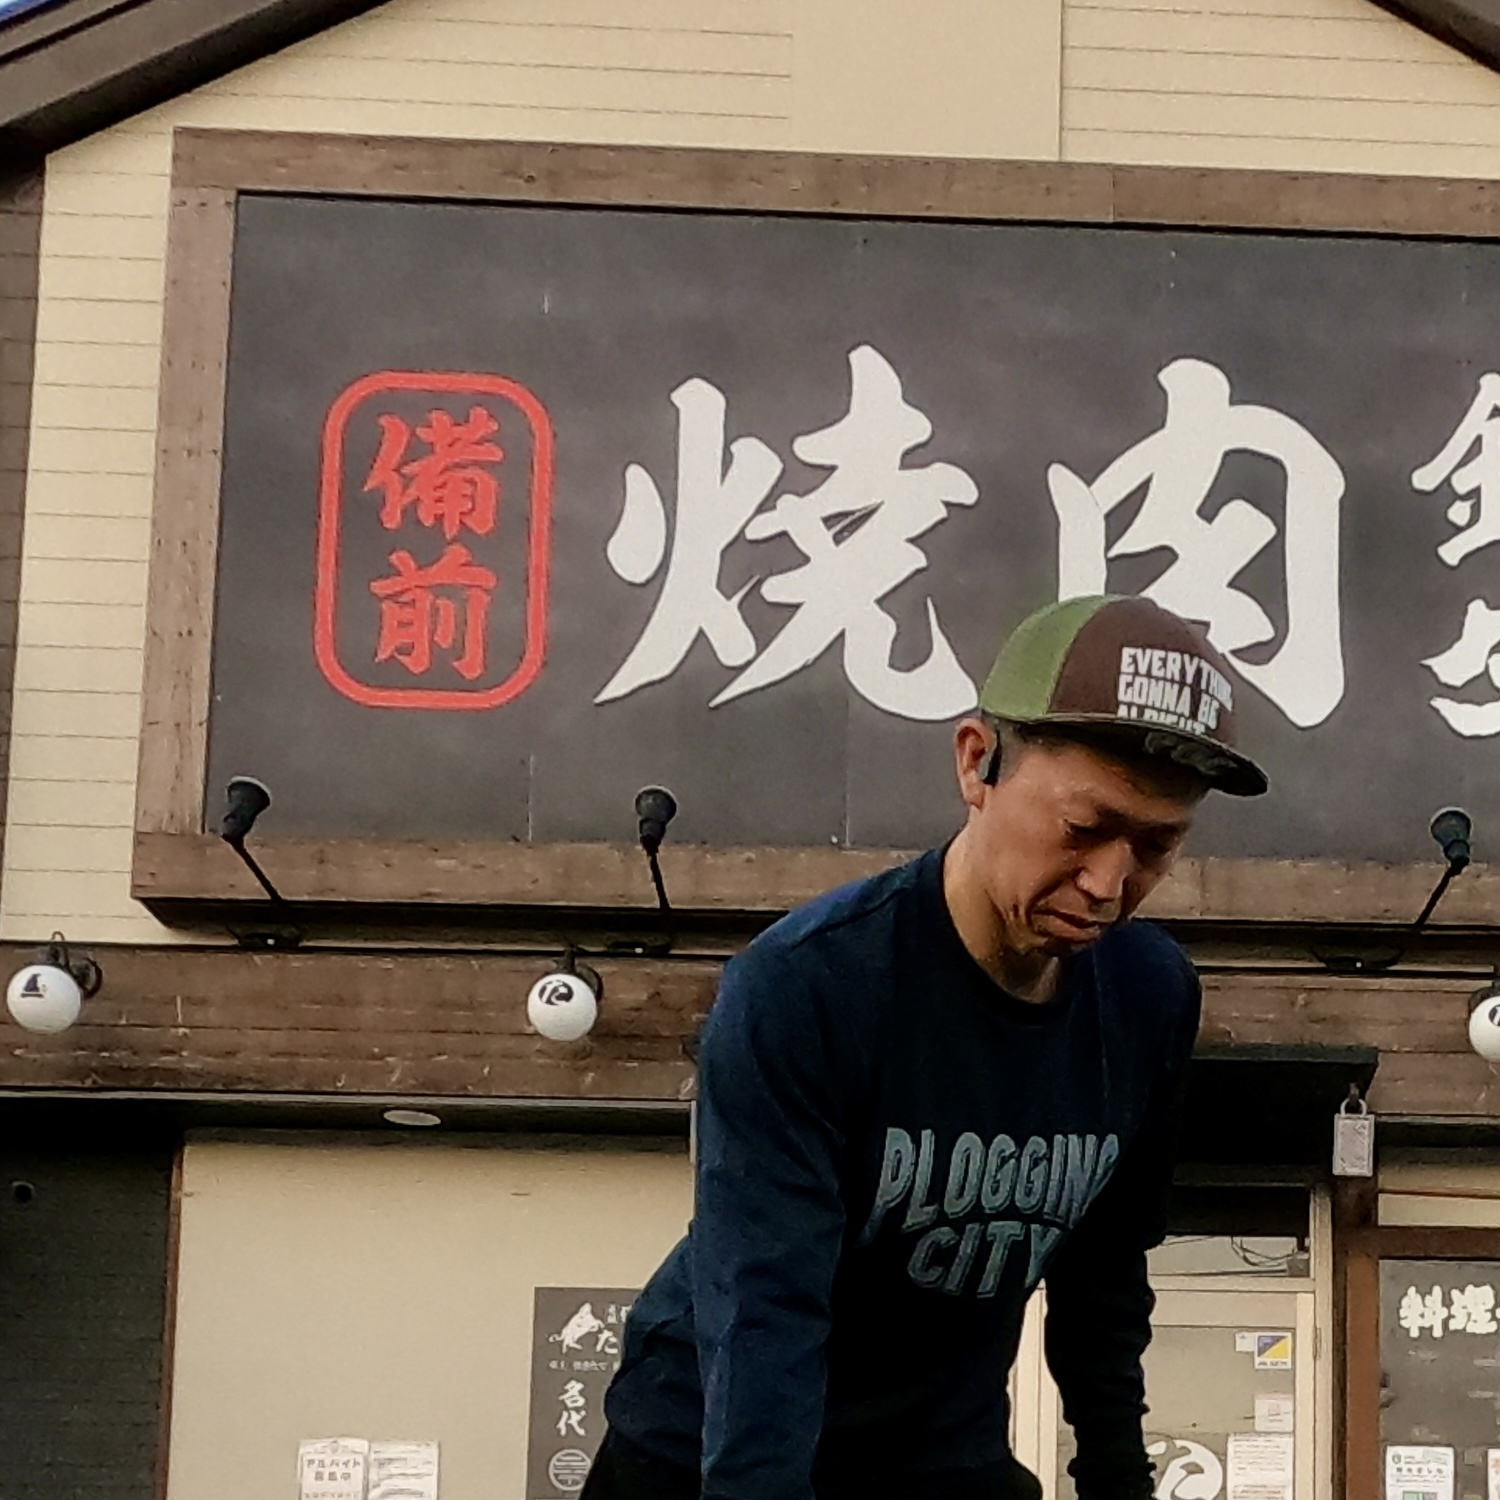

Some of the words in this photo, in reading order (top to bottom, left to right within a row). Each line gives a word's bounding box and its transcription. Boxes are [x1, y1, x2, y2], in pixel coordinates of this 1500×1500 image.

[363, 405, 506, 681] 備前
[594, 343, 1345, 729] 焼肉
[1117, 674, 1192, 717] GONNA
[853, 1126, 1119, 1248] PLOGGING
[907, 1220, 1061, 1299] CITY
[555, 1379, 589, 1438] 名代
